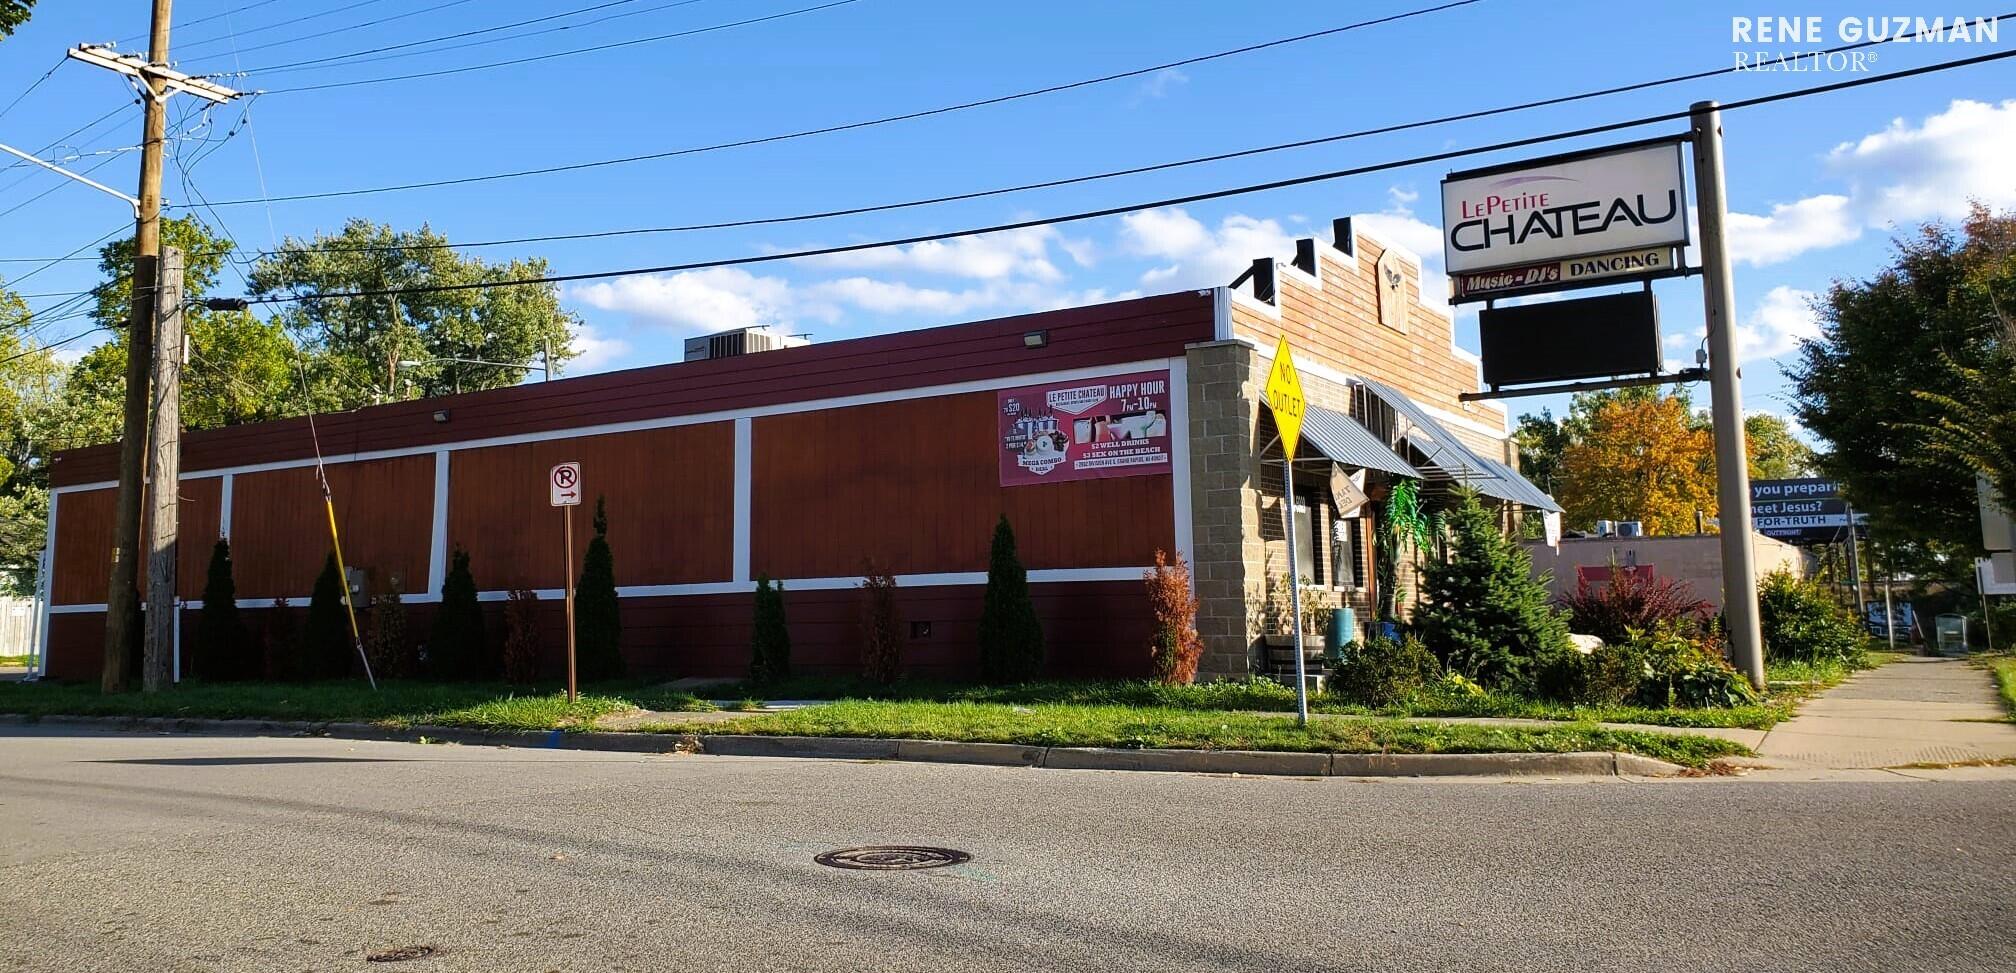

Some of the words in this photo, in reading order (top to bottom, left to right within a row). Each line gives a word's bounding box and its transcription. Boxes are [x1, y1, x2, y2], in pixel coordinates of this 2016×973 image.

[1450, 189, 1676, 251] CHATEAU
[1570, 252, 1660, 276] DANCING
[1279, 361, 1291, 384] NO
[1049, 393, 1056, 402] LE
[1057, 391, 1077, 401] PETITE
[1078, 387, 1105, 399] CHATEAU
[1109, 384, 1138, 399] HAPPY
[1140, 381, 1165, 395] HOUR
[1273, 389, 1301, 418] OUTLET
[1121, 438, 1150, 447] DRINKS
[1135, 446, 1160, 454] BEACH
[1754, 486, 1780, 497] you
[1780, 501, 1823, 513] Jesus?
[1757, 515, 1827, 526] FOR-TRUTH
